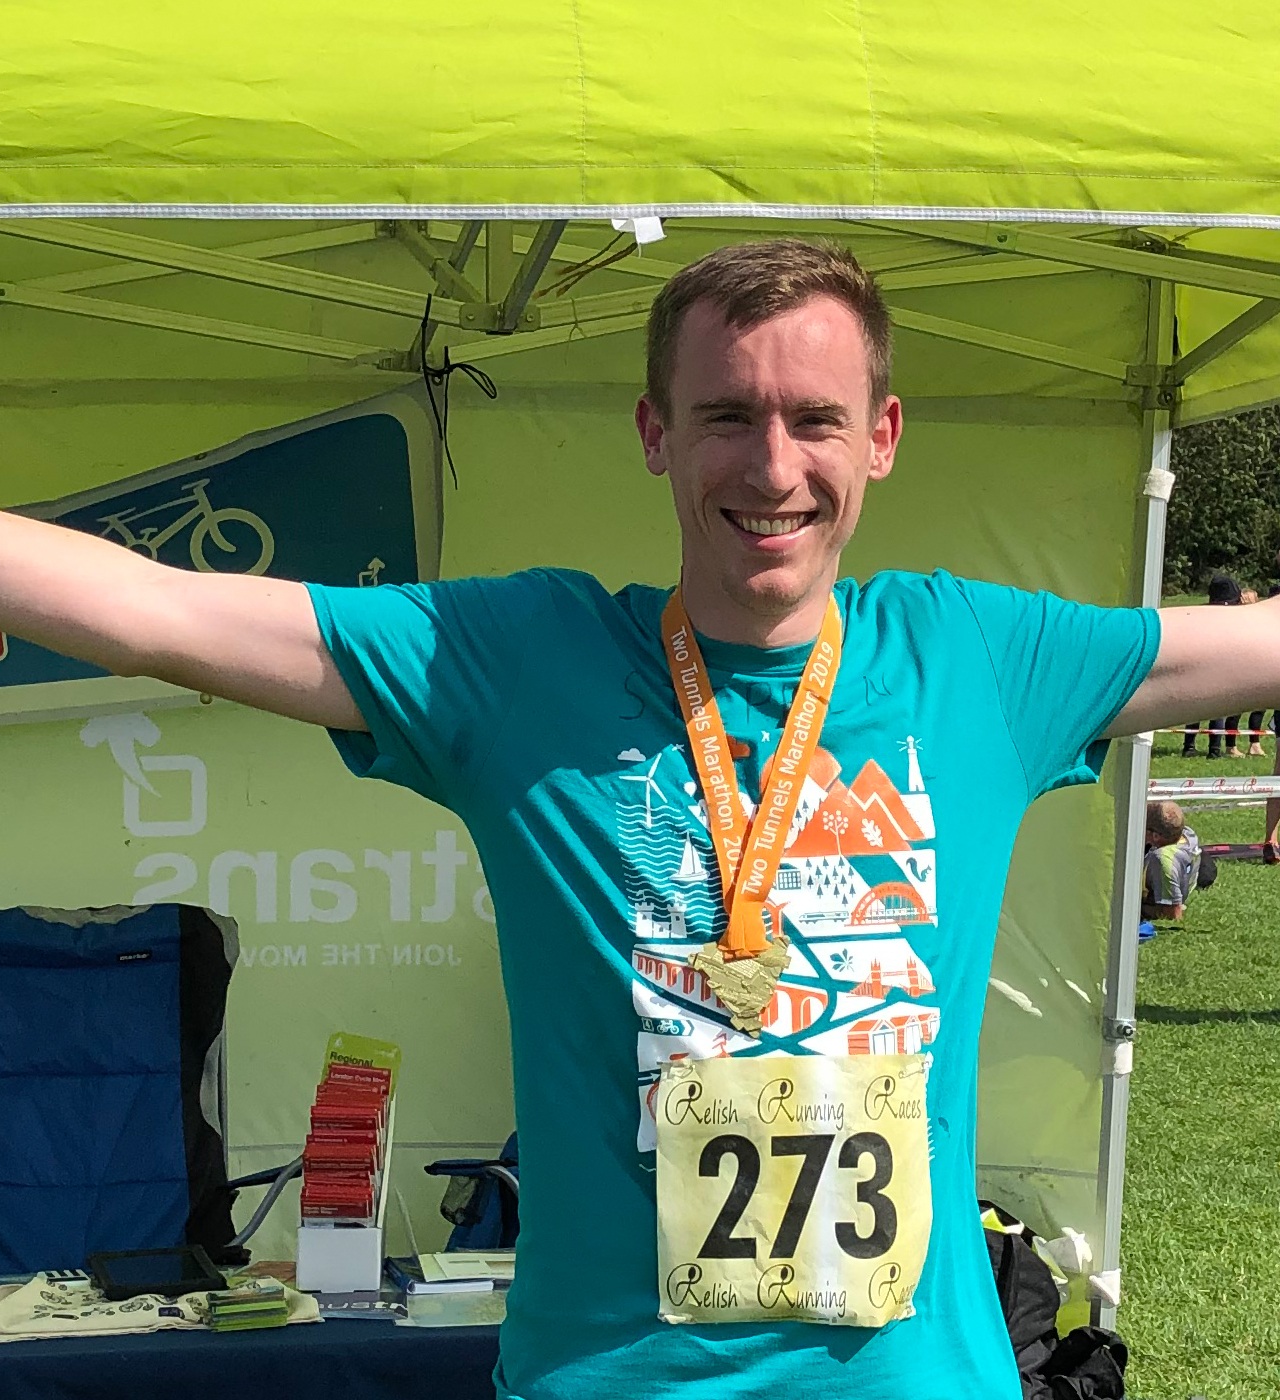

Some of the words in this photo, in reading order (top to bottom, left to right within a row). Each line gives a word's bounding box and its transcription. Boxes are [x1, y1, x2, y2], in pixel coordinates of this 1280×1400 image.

[808, 641, 834, 688] 2019
[670, 625, 689, 662] Two
[680, 662, 712, 732] Tunnels
[700, 735, 734, 831] Marathon
[778, 690, 819, 776] Marathon
[754, 779, 794, 850] Tunnels
[741, 858, 768, 895] Two
[329, 1051, 375, 1068] Regional
[665, 1080, 739, 1126] Relish
[757, 1077, 845, 1130] Running
[864, 1075, 922, 1121] Races
[697, 1131, 898, 1260] 273
[666, 1263, 738, 1309] Relish
[757, 1263, 847, 1318] Running
